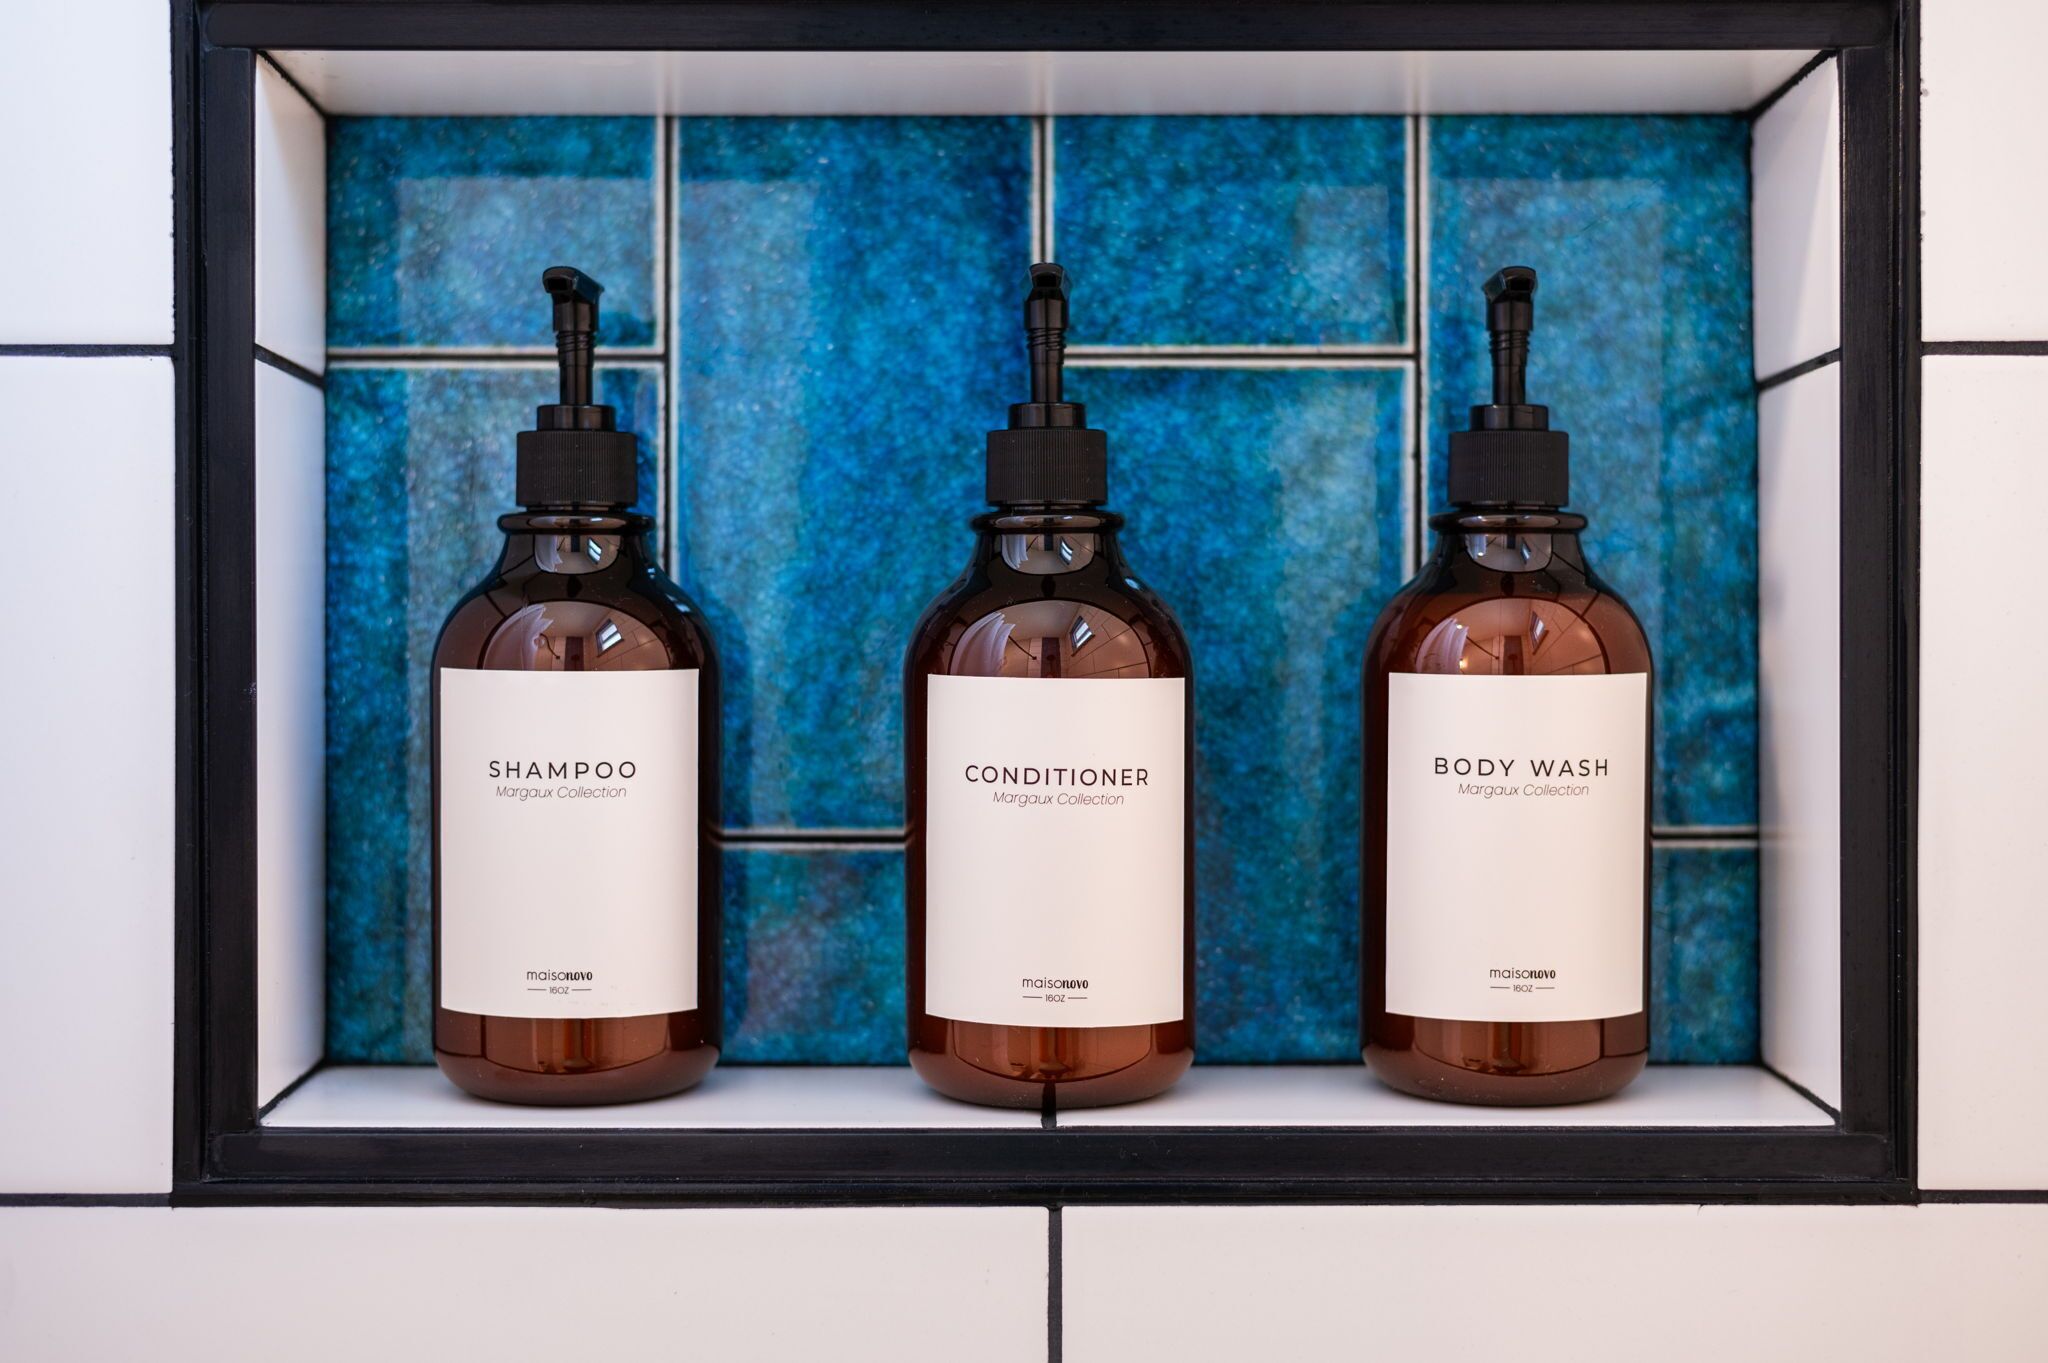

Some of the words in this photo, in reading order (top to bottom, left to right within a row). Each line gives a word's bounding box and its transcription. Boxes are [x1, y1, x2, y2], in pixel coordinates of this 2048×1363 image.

[489, 760, 637, 780] SHAMPOO
[1435, 757, 1515, 777] BODY
[1530, 758, 1608, 778] WASH
[964, 765, 1149, 787] CONDITIONER
[496, 785, 553, 802] Margaux
[557, 786, 627, 799] Collection
[1458, 783, 1519, 799] Margaux
[1522, 784, 1589, 798] Collection
[993, 792, 1053, 808] Margaux
[1057, 793, 1125, 806] Collection
[526, 969, 593, 981] maisonovo
[1489, 968, 1557, 980] maisonovo
[1022, 976, 1089, 990] maisonovo
